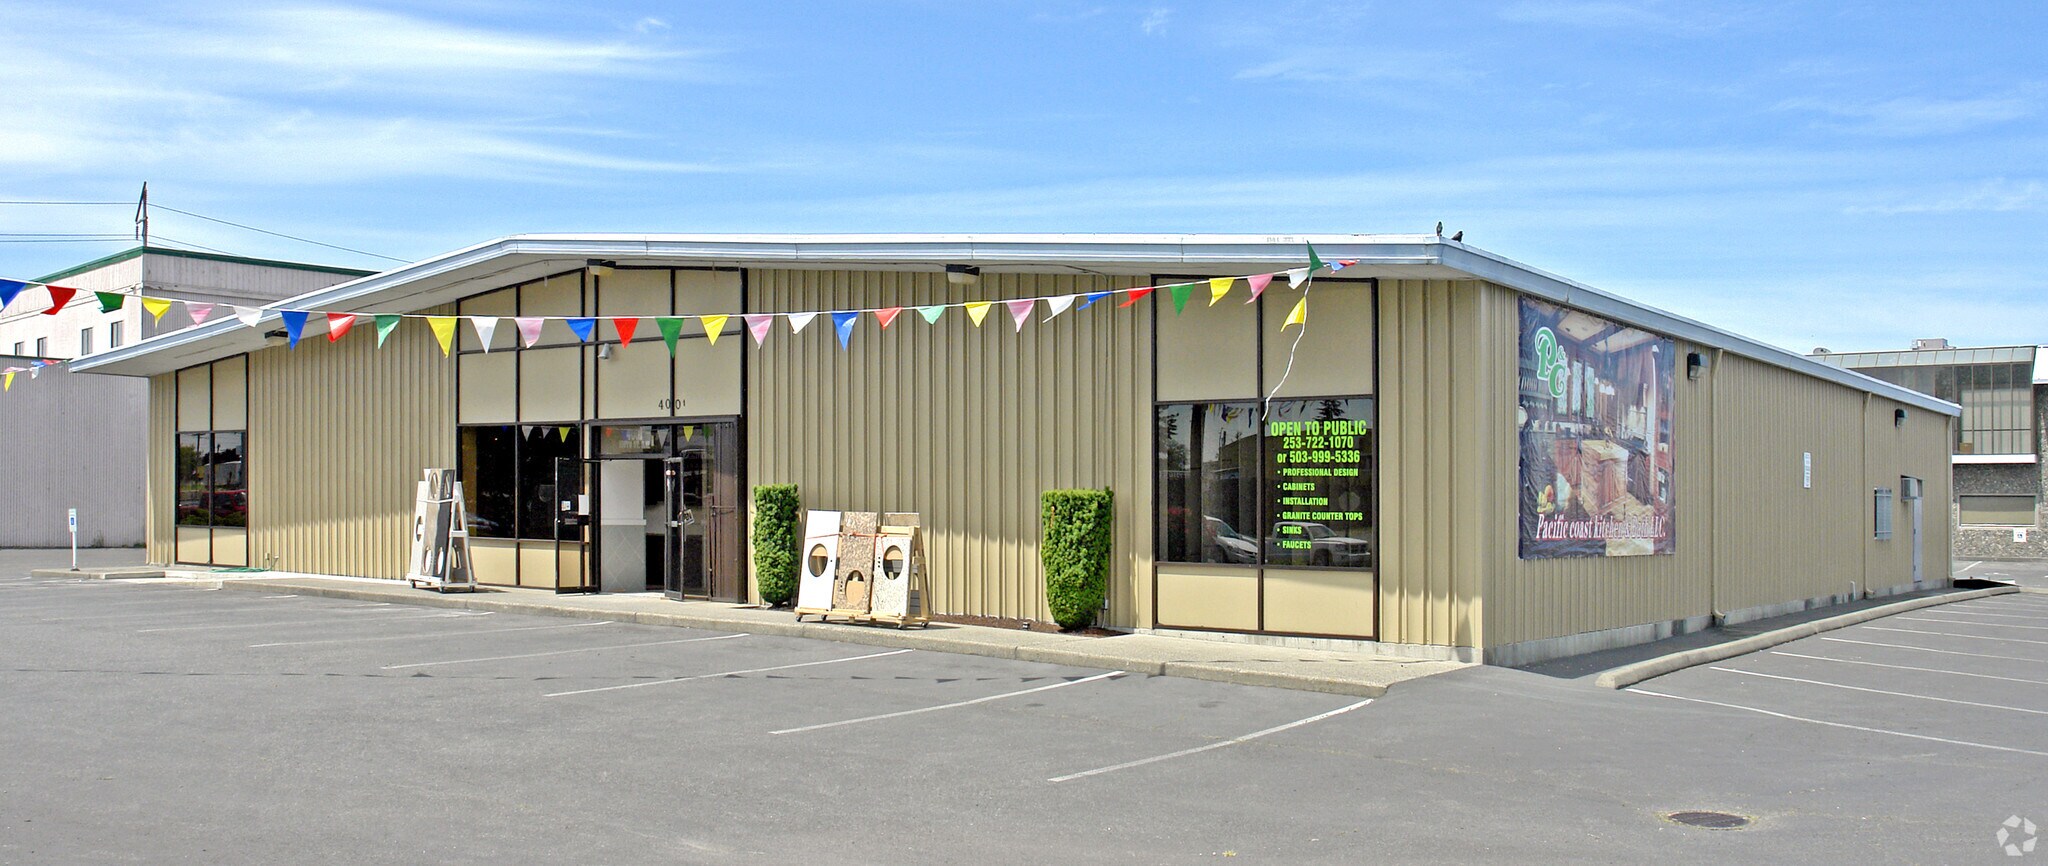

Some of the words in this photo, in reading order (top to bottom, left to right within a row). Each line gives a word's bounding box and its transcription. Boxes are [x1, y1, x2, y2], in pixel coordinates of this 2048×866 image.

[1271, 421, 1301, 436] OPEN
[1305, 421, 1320, 435] TO
[1323, 420, 1367, 435] PUBLIC
[1283, 436, 1354, 449] 253-722-1070
[1277, 453, 1287, 463] or
[1289, 450, 1361, 463] 503-999-5336
[1282, 468, 1332, 476] PROFESSIONAL
[1333, 468, 1359, 476] DESIGN
[1282, 482, 1315, 491] CABINETS
[1282, 497, 1328, 506] INSTALLATION
[1282, 511, 1311, 520] GRANITE
[1312, 512, 1343, 520] COUNTER
[1345, 512, 1363, 521] TOPS
[1282, 526, 1302, 535] SINKS
[1536, 513, 1569, 539] Pacific
[1569, 517, 1593, 539] coast
[1282, 541, 1312, 549] FAUCETS
